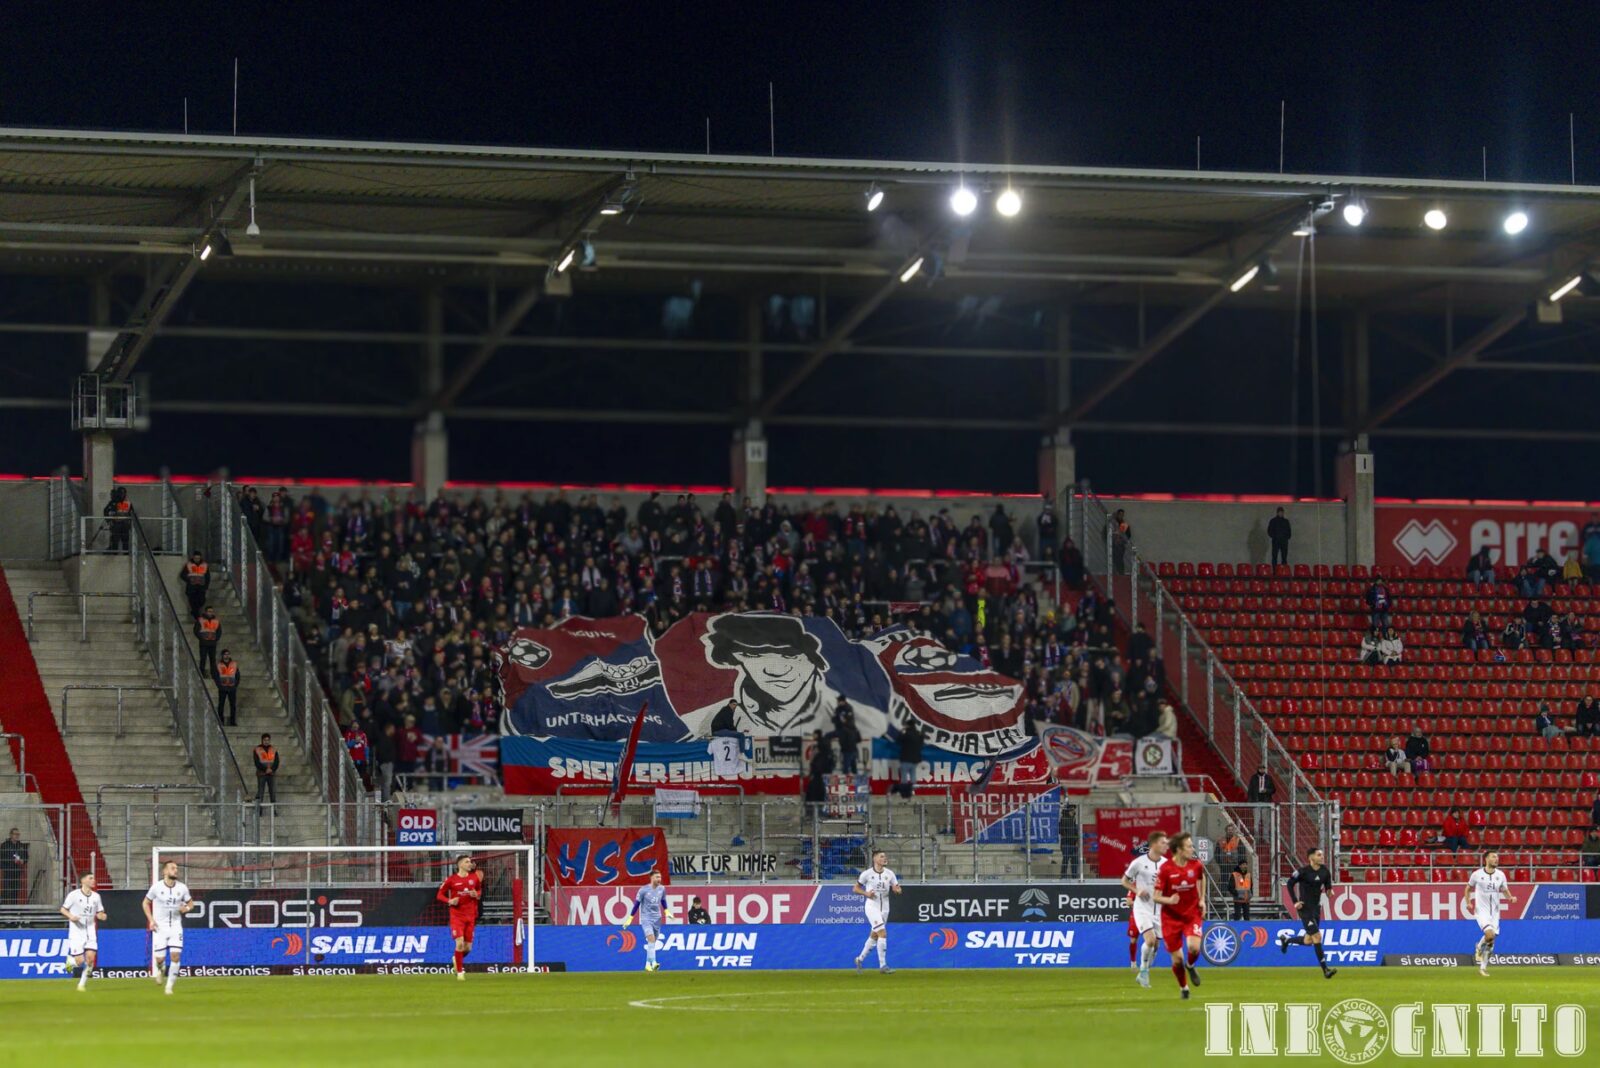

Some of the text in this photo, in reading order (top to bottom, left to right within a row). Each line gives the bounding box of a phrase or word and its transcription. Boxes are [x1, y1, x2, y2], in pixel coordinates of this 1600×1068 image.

[546, 711, 663, 728] UNTERHACHNG
[723, 745, 731, 762] 2
[959, 792, 1053, 817] HACHING
[400, 815, 434, 830] OLD
[457, 816, 521, 833] SENDLING
[964, 817, 1051, 840] ON TOUR
[399, 831, 434, 843] BOYS
[557, 834, 658, 885] HSC
[738, 853, 777, 873] IMMER
[832, 893, 865, 902] Parsberg
[1547, 891, 1580, 901] Parsberg
[567, 886, 791, 925] MÖEHOF
[828, 904, 865, 914] Ingolstadt
[918, 898, 1010, 921] guSTAFF
[1545, 902, 1580, 912] Ingolstadt
[815, 916, 865, 924] moebelhof.de
[311, 935, 429, 954] SAILUN
[643, 932, 757, 951] SAILUN
[965, 930, 1075, 948] SAILUN
[695, 955, 753, 968] TYRE
[1014, 952, 1071, 965] TYRE
[1323, 950, 1378, 962] TYRE
[1400, 955, 1458, 968] si energy
[1488, 953, 1556, 966] electronics
[1573, 954, 1584, 965] si
[19, 962, 73, 974] TYR
[91, 968, 104, 978] si
[178, 965, 271, 977] si electronics
[292, 966, 306, 976] si
[376, 964, 466, 975] si electroni
[486, 964, 500, 974] si
